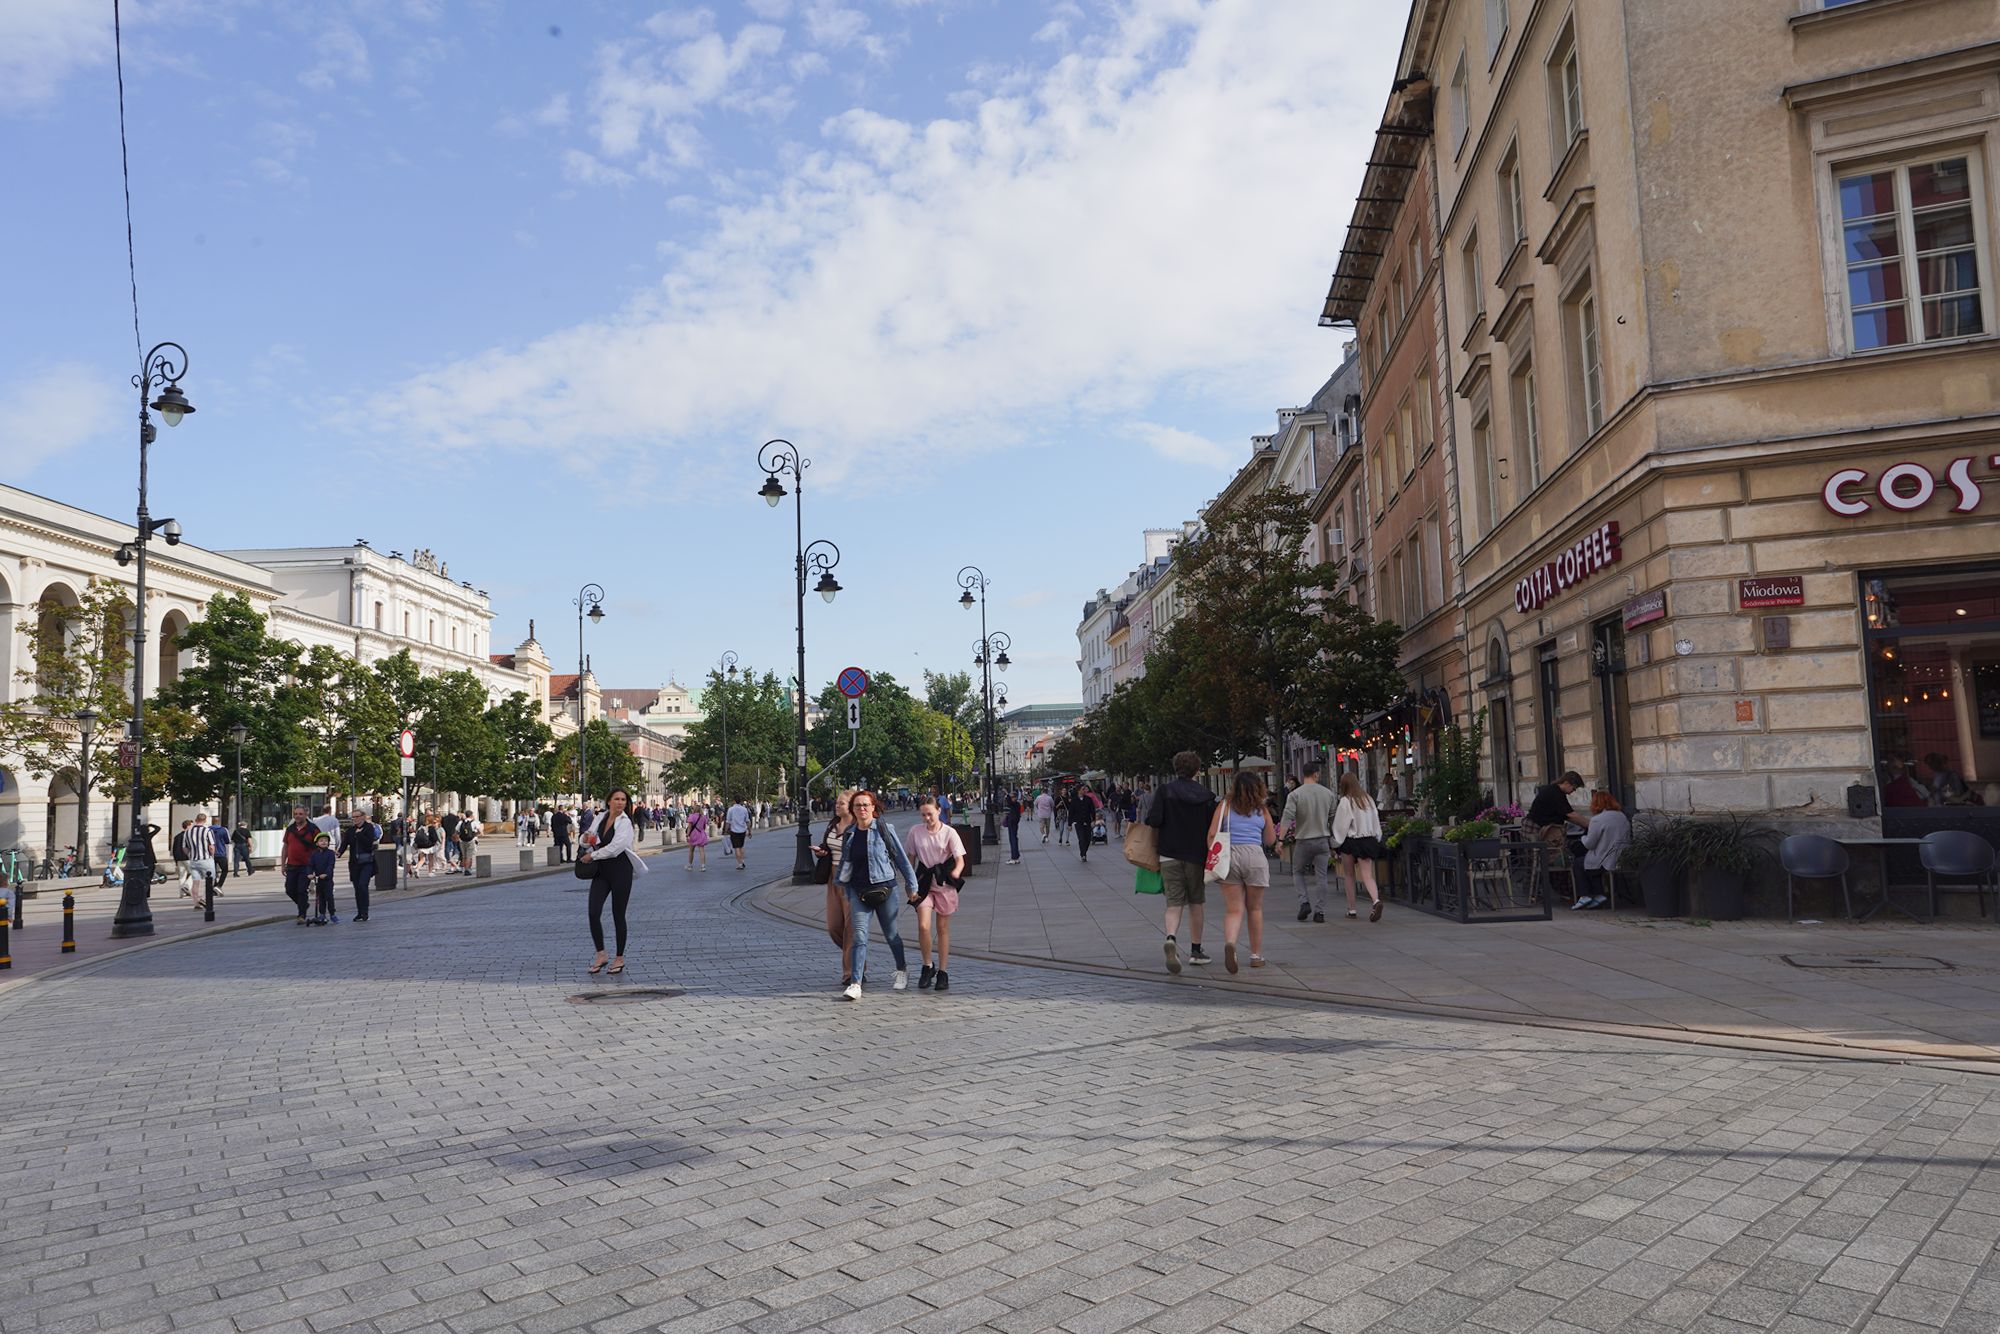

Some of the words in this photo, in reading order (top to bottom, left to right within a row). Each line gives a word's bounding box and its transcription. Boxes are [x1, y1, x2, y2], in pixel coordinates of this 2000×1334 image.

[1823, 454, 2000, 519] COS
[1514, 564, 1557, 613] COSTA
[1555, 522, 1617, 589] COFFEE
[1743, 584, 1801, 598] Miodowa
[127, 744, 137, 752] WC
